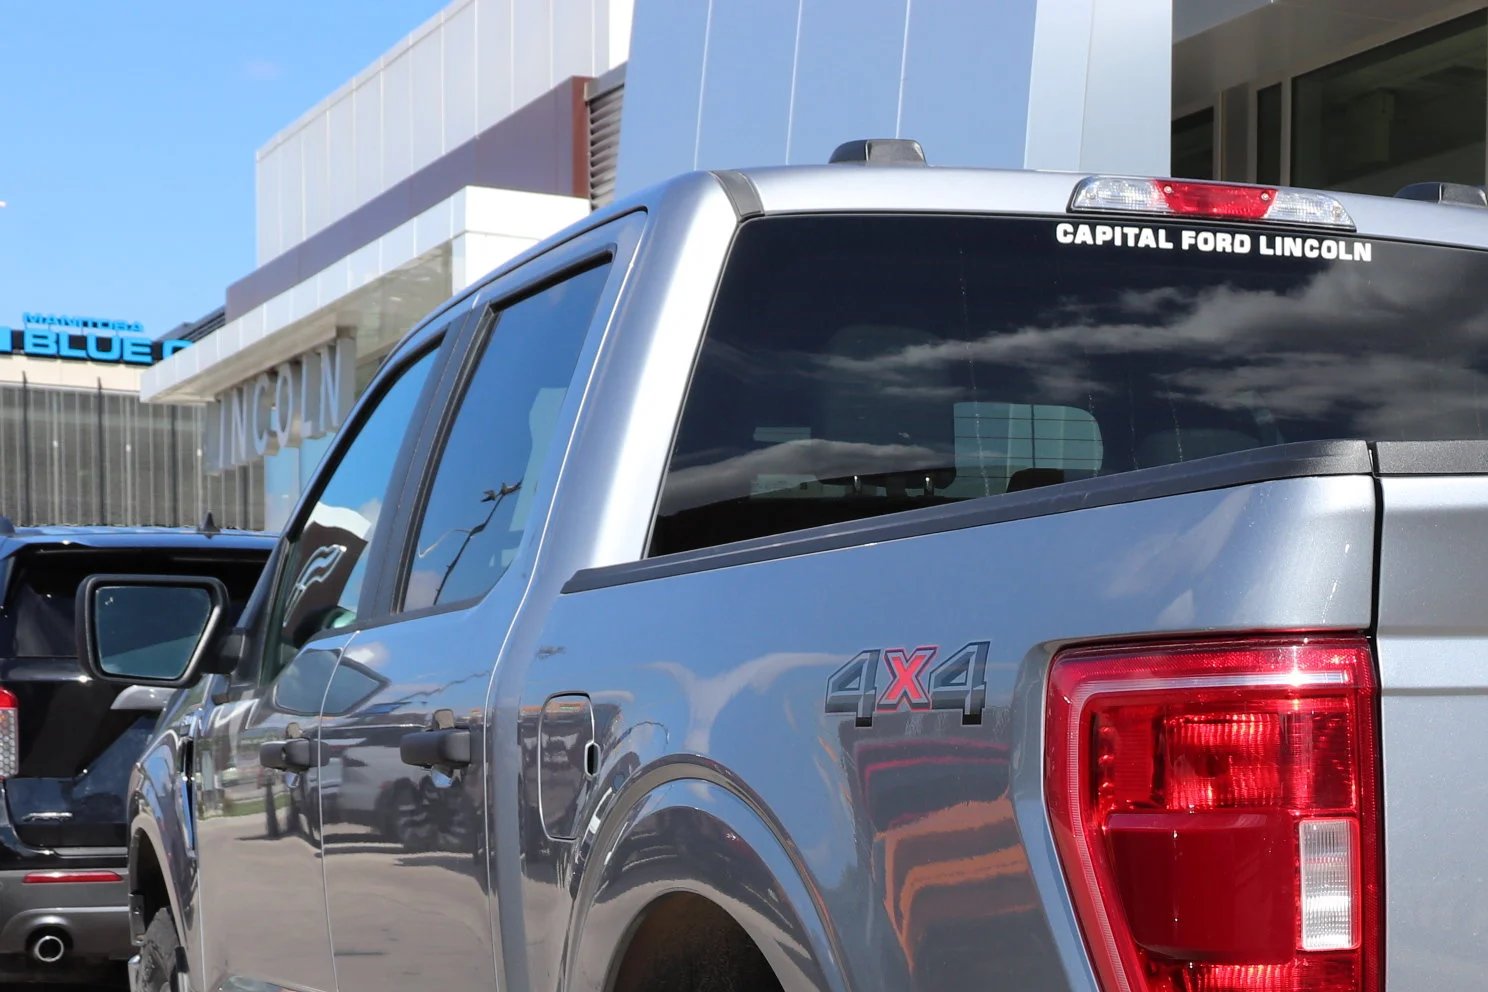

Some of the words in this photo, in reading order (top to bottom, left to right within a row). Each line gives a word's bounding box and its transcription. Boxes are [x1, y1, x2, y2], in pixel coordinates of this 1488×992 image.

[1055, 222, 1174, 250] CAPITAL
[1181, 230, 1251, 254] FORD
[1259, 235, 1372, 262] LINCOLN
[24, 328, 153, 364] BLUE
[204, 336, 344, 473] INCOLN
